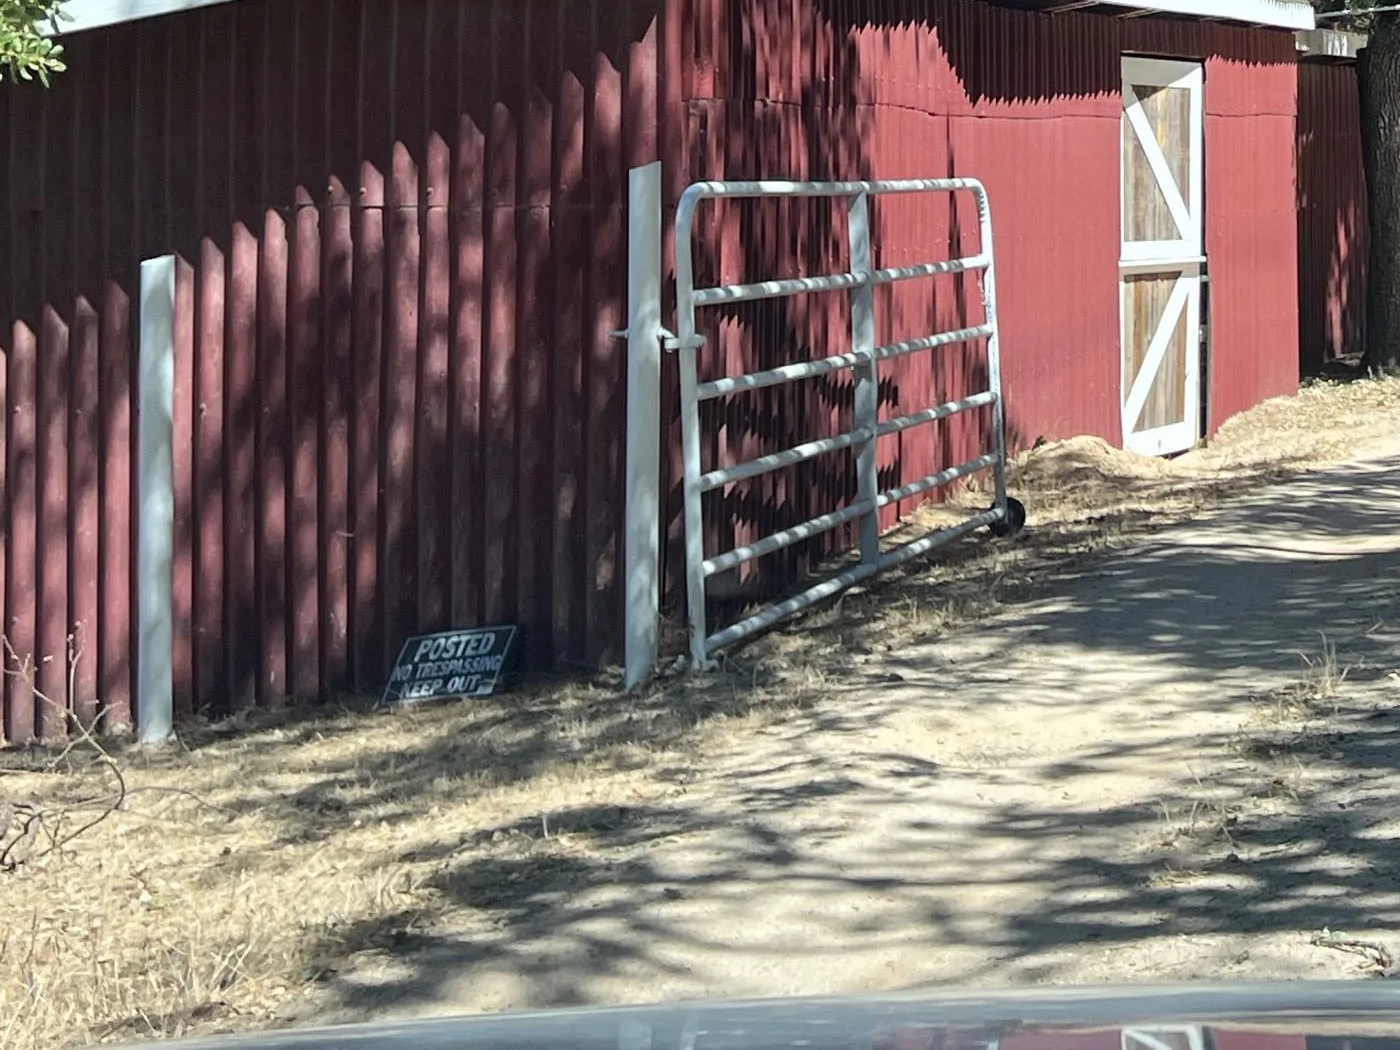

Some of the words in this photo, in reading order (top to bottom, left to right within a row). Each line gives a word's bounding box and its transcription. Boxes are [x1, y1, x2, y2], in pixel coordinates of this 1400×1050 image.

[414, 633, 496, 662] POSTED
[392, 664, 412, 681] NO
[416, 654, 503, 679] TRESPASSING
[401, 679, 443, 698] KEEP
[447, 675, 481, 693] OUT
